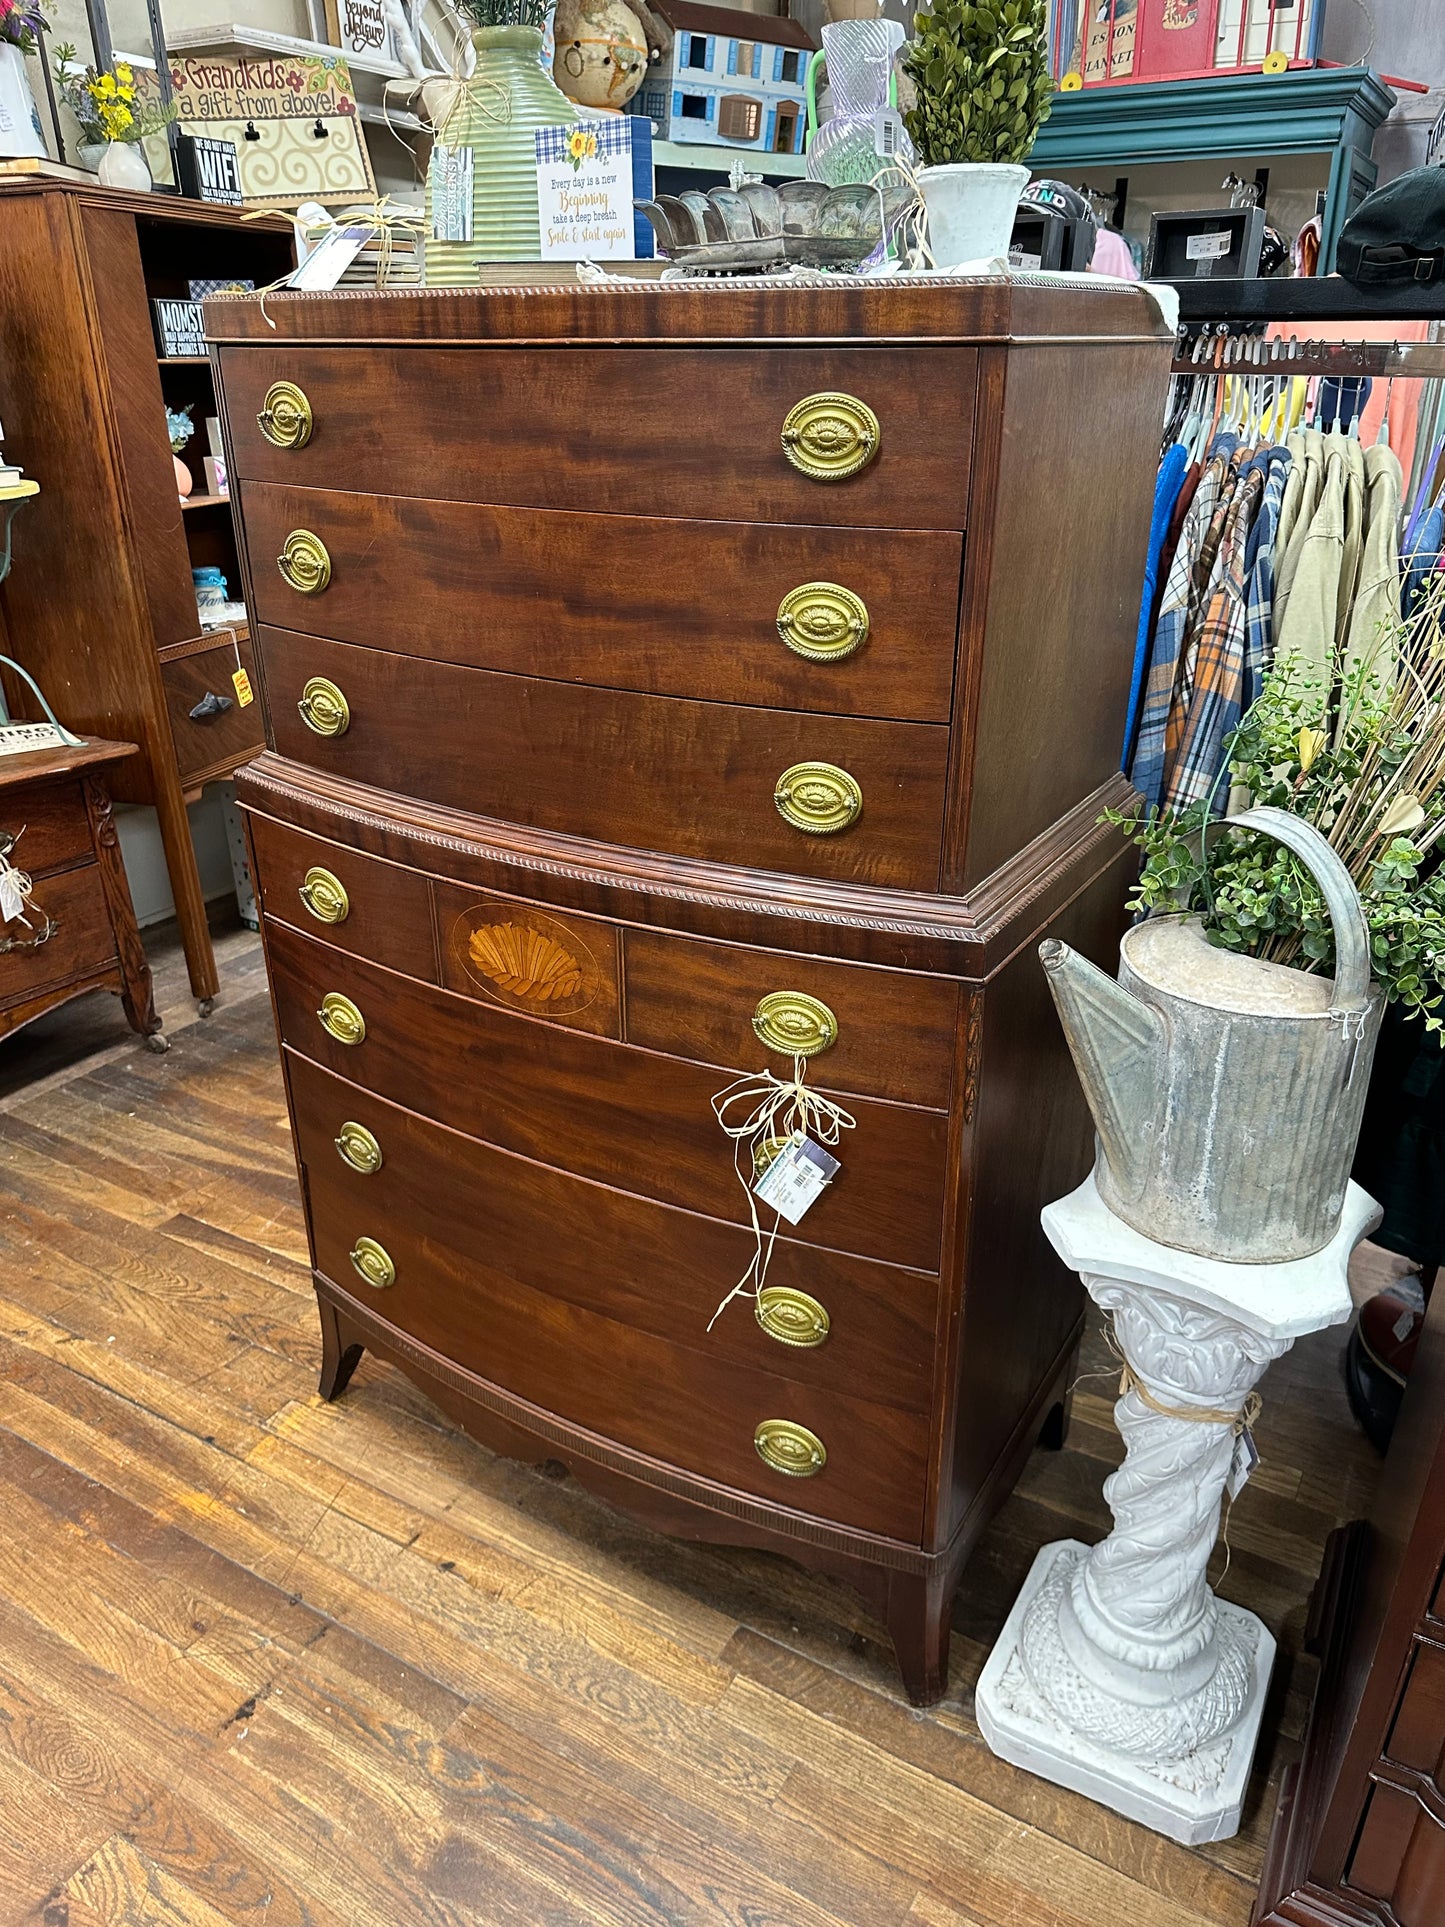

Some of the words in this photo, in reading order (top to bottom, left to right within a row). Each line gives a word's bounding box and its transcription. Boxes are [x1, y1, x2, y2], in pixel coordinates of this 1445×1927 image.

[185, 59, 285, 90] Grandkids
[180, 94, 195, 116] a
[199, 89, 232, 116] gift
[235, 89, 278, 115] from
[280, 87, 336, 114] above!
[203, 139, 212, 150] DO
[211, 141, 222, 152] NOT
[222, 142, 236, 155] HAVE
[196, 149, 241, 191] WIFI
[551, 179, 571, 190] Every
[573, 177, 585, 188] day
[587, 176, 593, 186] is
[601, 174, 617, 184] new
[447, 164, 457, 226] DESIGNS
[559, 190, 608, 214] Beginning
[1018, 188, 1066, 209] KIND
[553, 214, 567, 224] take
[575, 213, 591, 224] deep
[593, 210, 617, 221] breath
[582, 226, 600, 242] start
[603, 227, 626, 249] again
[167, 342, 178, 355] SHE
[177, 343, 198, 355] COUNTS
